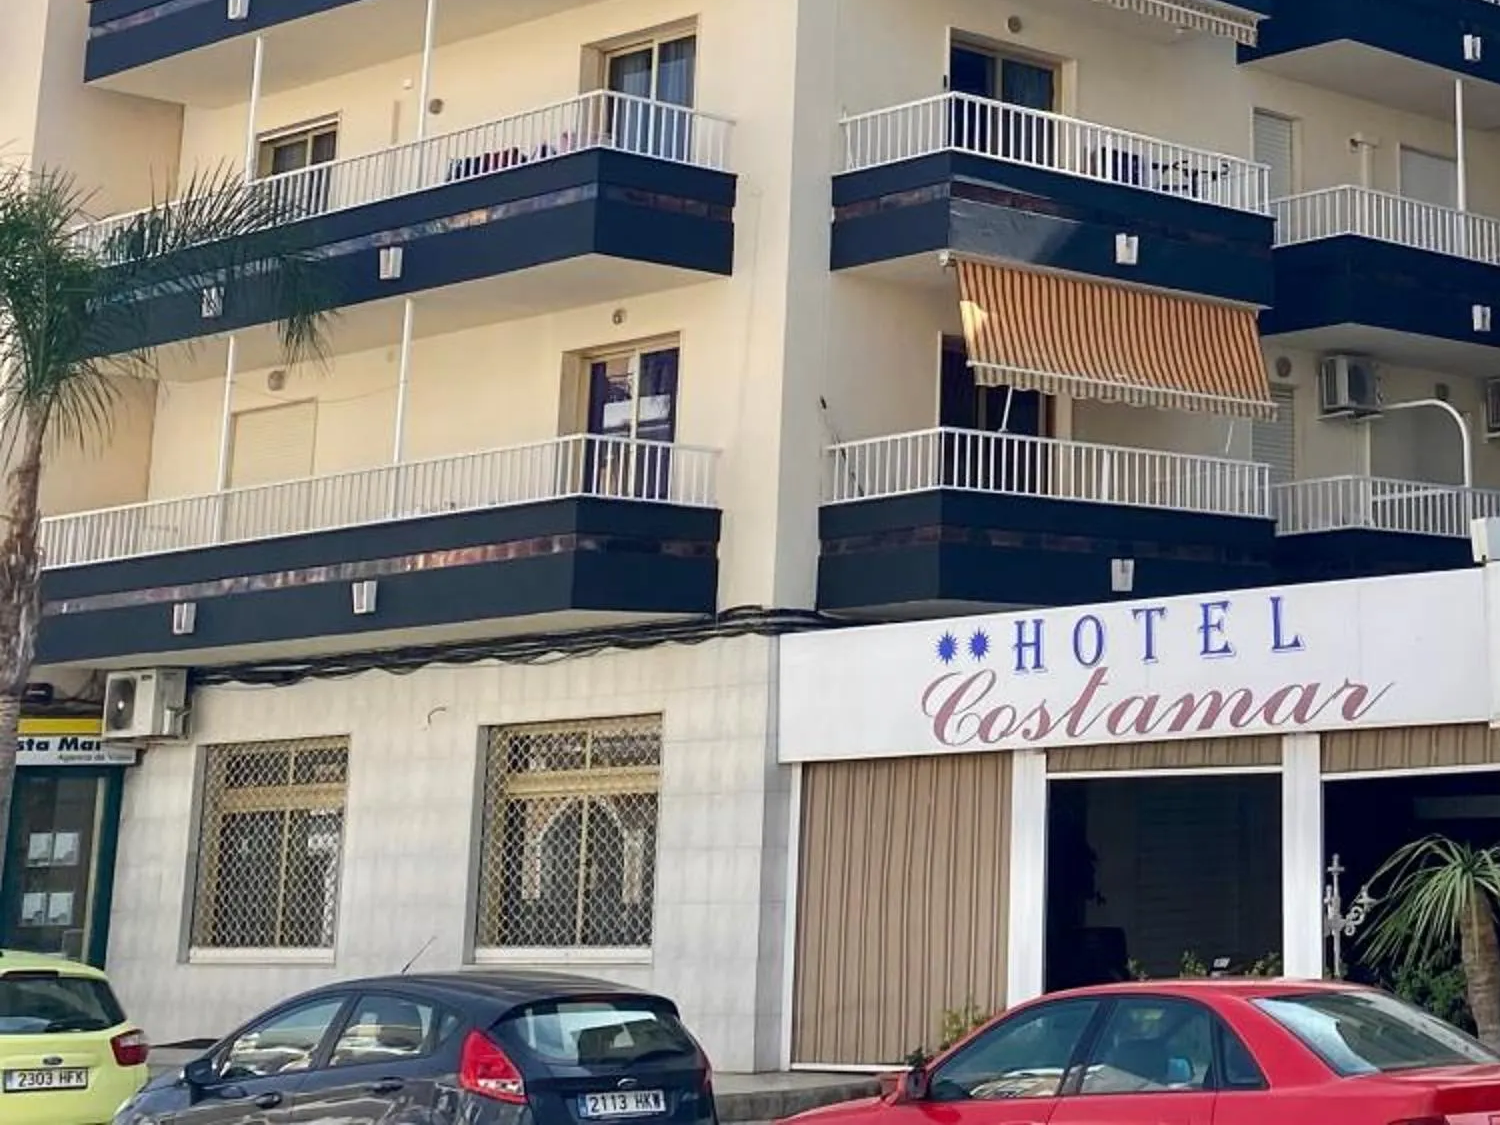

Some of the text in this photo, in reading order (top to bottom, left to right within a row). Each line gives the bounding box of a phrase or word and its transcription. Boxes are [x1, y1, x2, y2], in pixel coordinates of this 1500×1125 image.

[1013, 596, 1304, 673] HOTEL
[921, 666, 1394, 746] Costamar
[16, 738, 50, 752] sta
[18, 1072, 53, 1087] 2303
[589, 1094, 628, 1113] 2113
